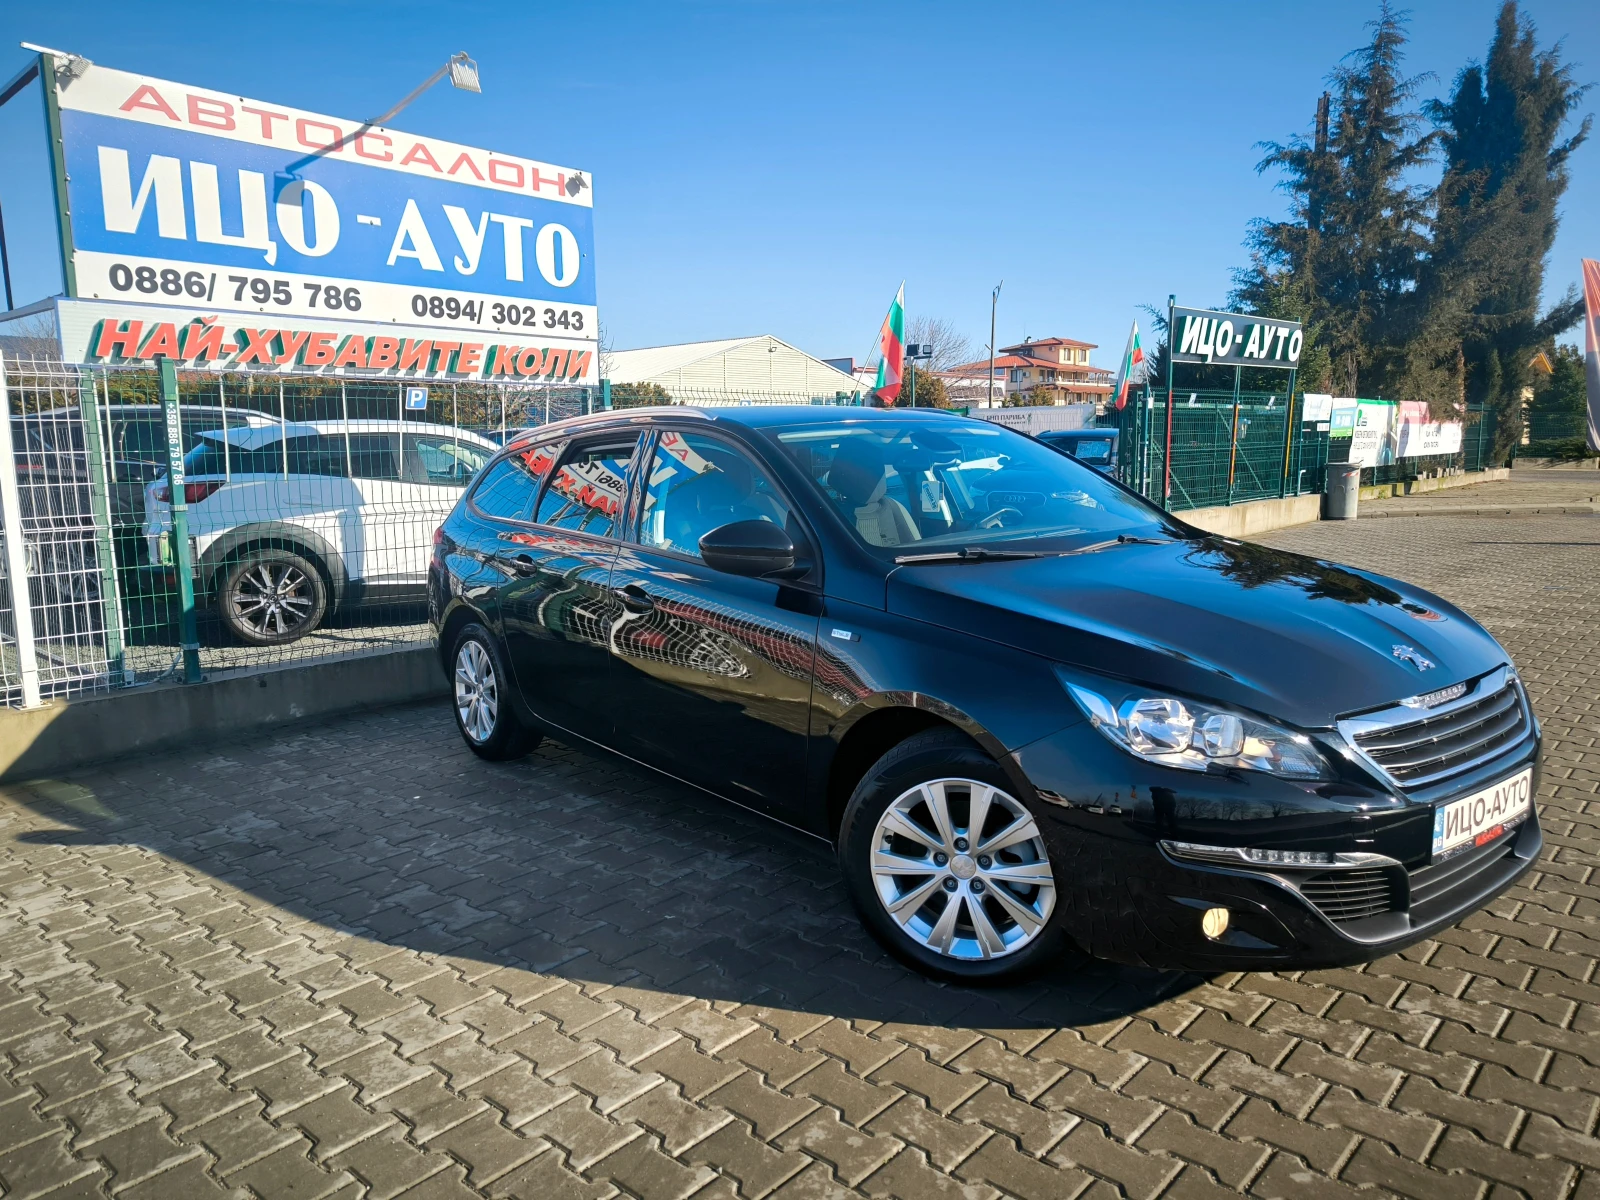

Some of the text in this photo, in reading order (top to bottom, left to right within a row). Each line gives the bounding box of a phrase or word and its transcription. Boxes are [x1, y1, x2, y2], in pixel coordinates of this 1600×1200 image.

[119, 85, 566, 197] АВТОСАЛОН
[109, 263, 362, 312] 0886/ 795 786
[411, 294, 584, 331] 0894/ 302 343
[93, 315, 592, 379] НАЙ-ХУБАВИТЕ КОЛИ
[1180, 315, 1303, 363] ИЦО-АУТО
[410, 389, 424, 407] P
[166, 402, 184, 486] +359 886 79 57 86
[1446, 775, 1529, 840] ИЦО-АУТО
